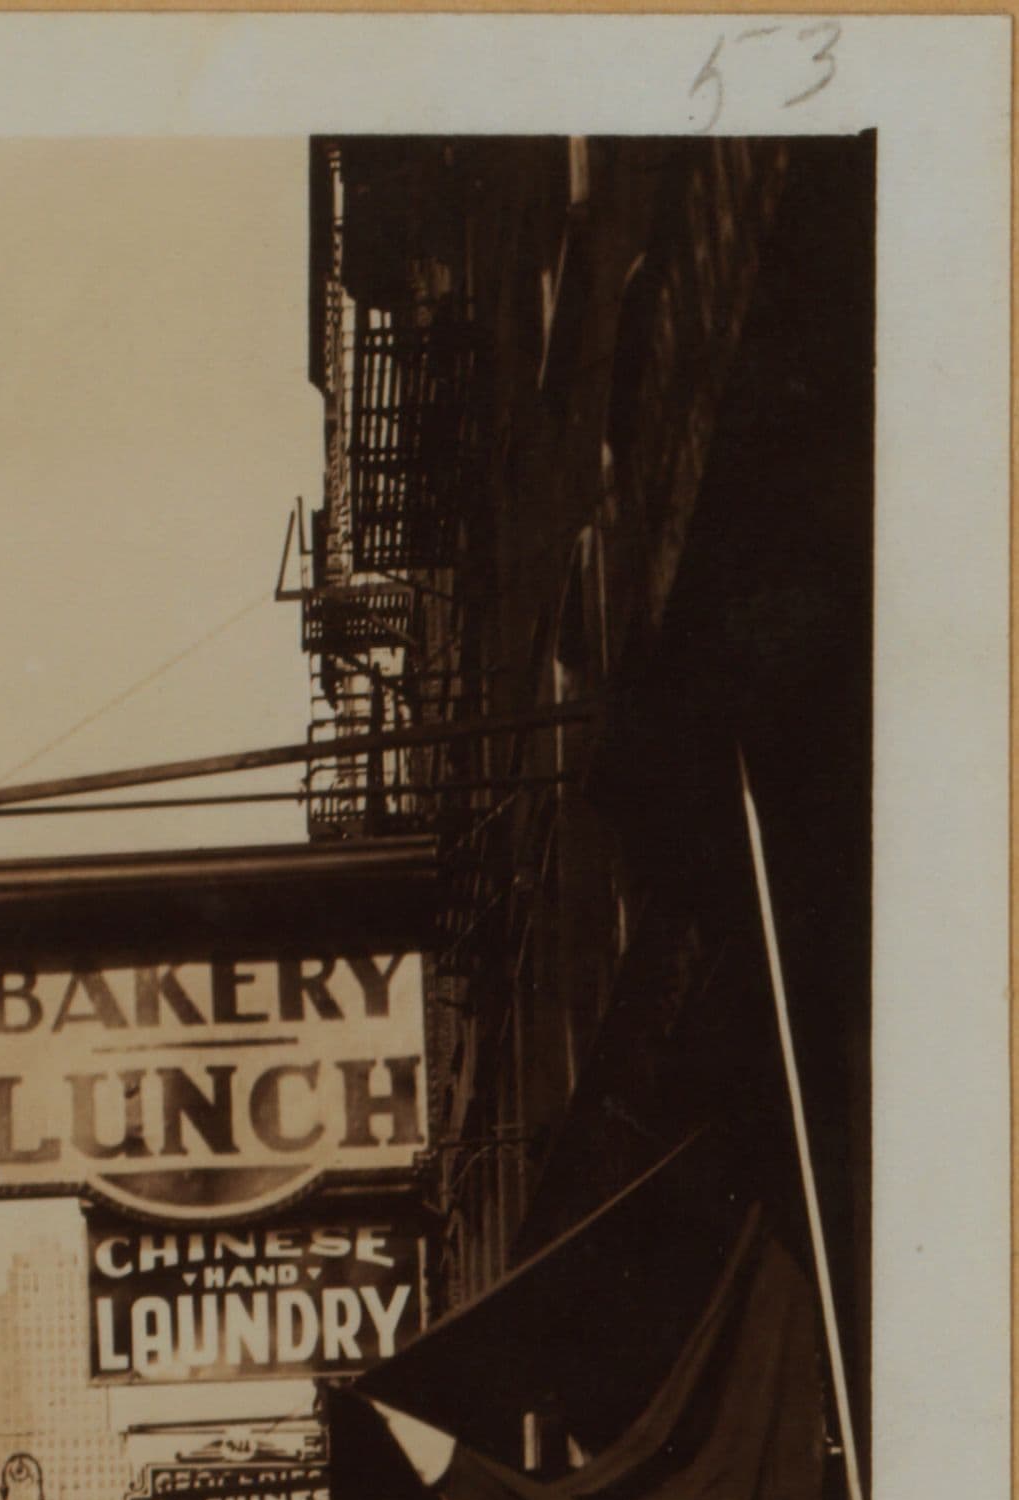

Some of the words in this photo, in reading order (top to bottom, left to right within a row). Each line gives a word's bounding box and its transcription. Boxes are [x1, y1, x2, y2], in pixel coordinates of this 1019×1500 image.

[688, 19, 842, 134] 53
[94, 1226, 396, 1278] CHINESE
[204, 1266, 298, 1289] HAND
[96, 1285, 412, 1376] LAUNDRY
